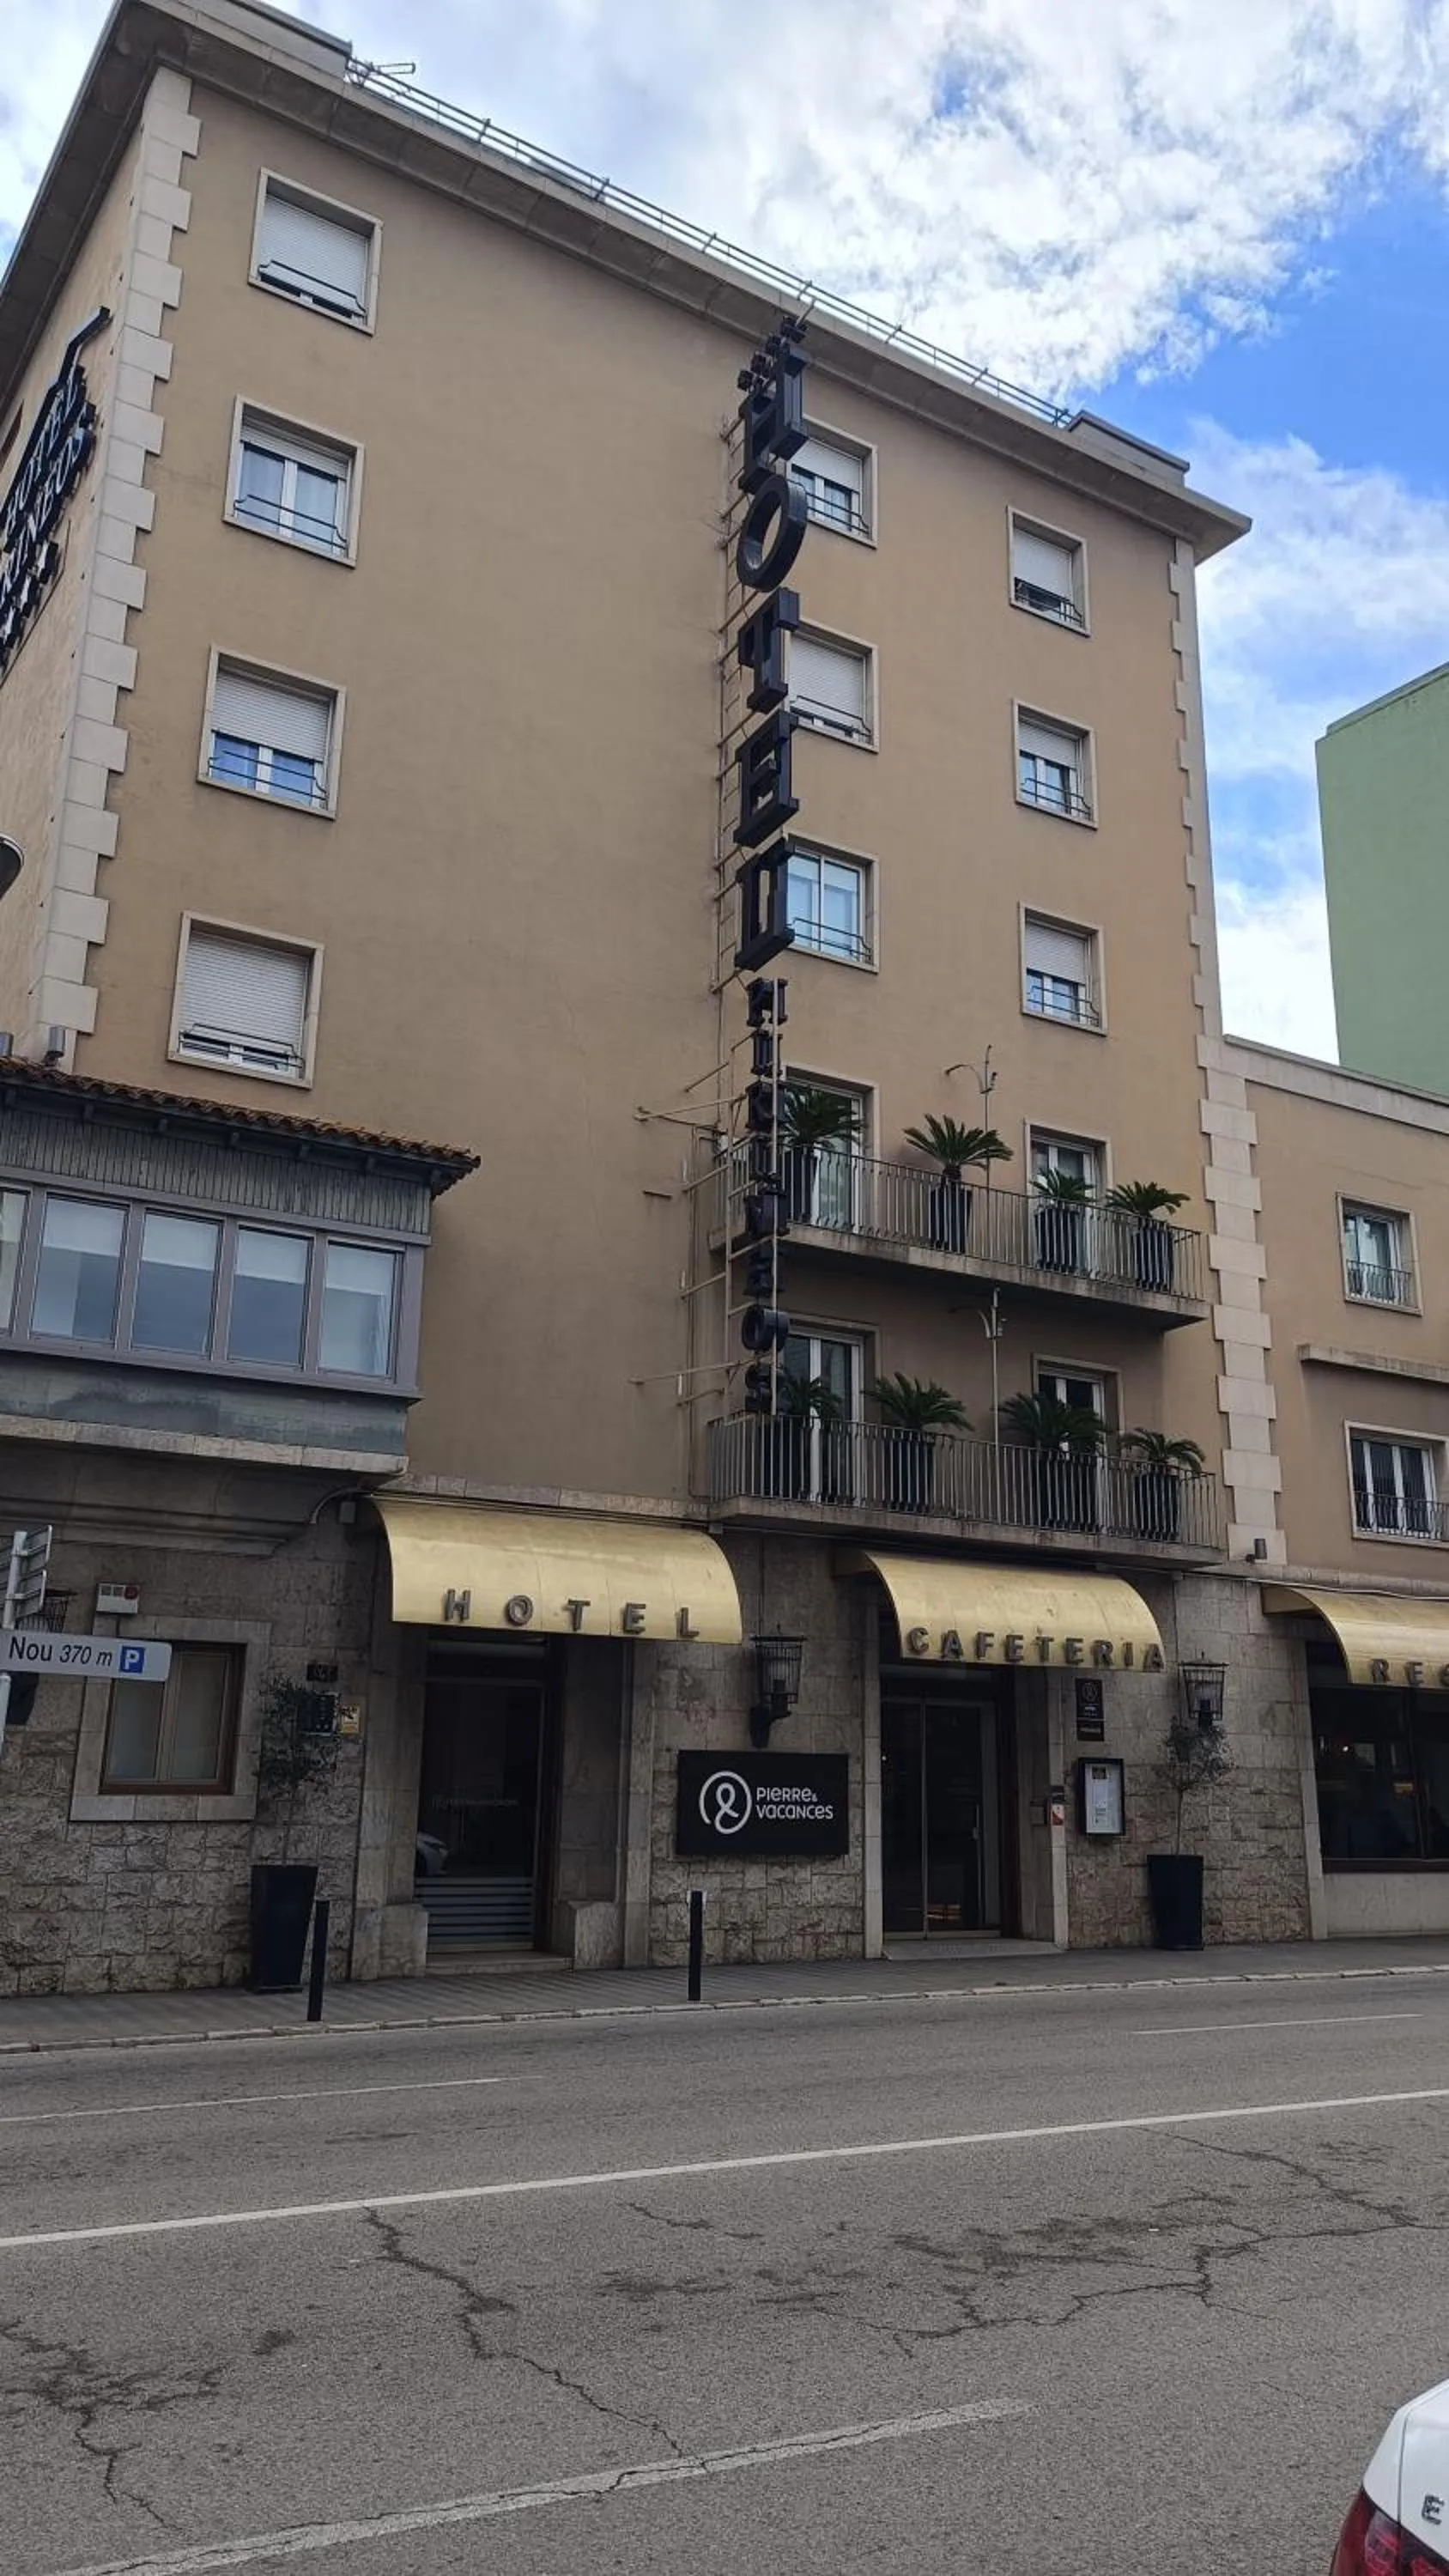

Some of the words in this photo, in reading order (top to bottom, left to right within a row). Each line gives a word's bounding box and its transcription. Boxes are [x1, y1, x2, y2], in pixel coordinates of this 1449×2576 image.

[734, 342, 809, 972] HOTEL
[444, 1589, 700, 1638] HOTEL
[9, 1637, 52, 1662] Nou
[59, 1644, 92, 1665] 370
[96, 1650, 112, 1667] m
[907, 1627, 1164, 1671] CAFETERIA
